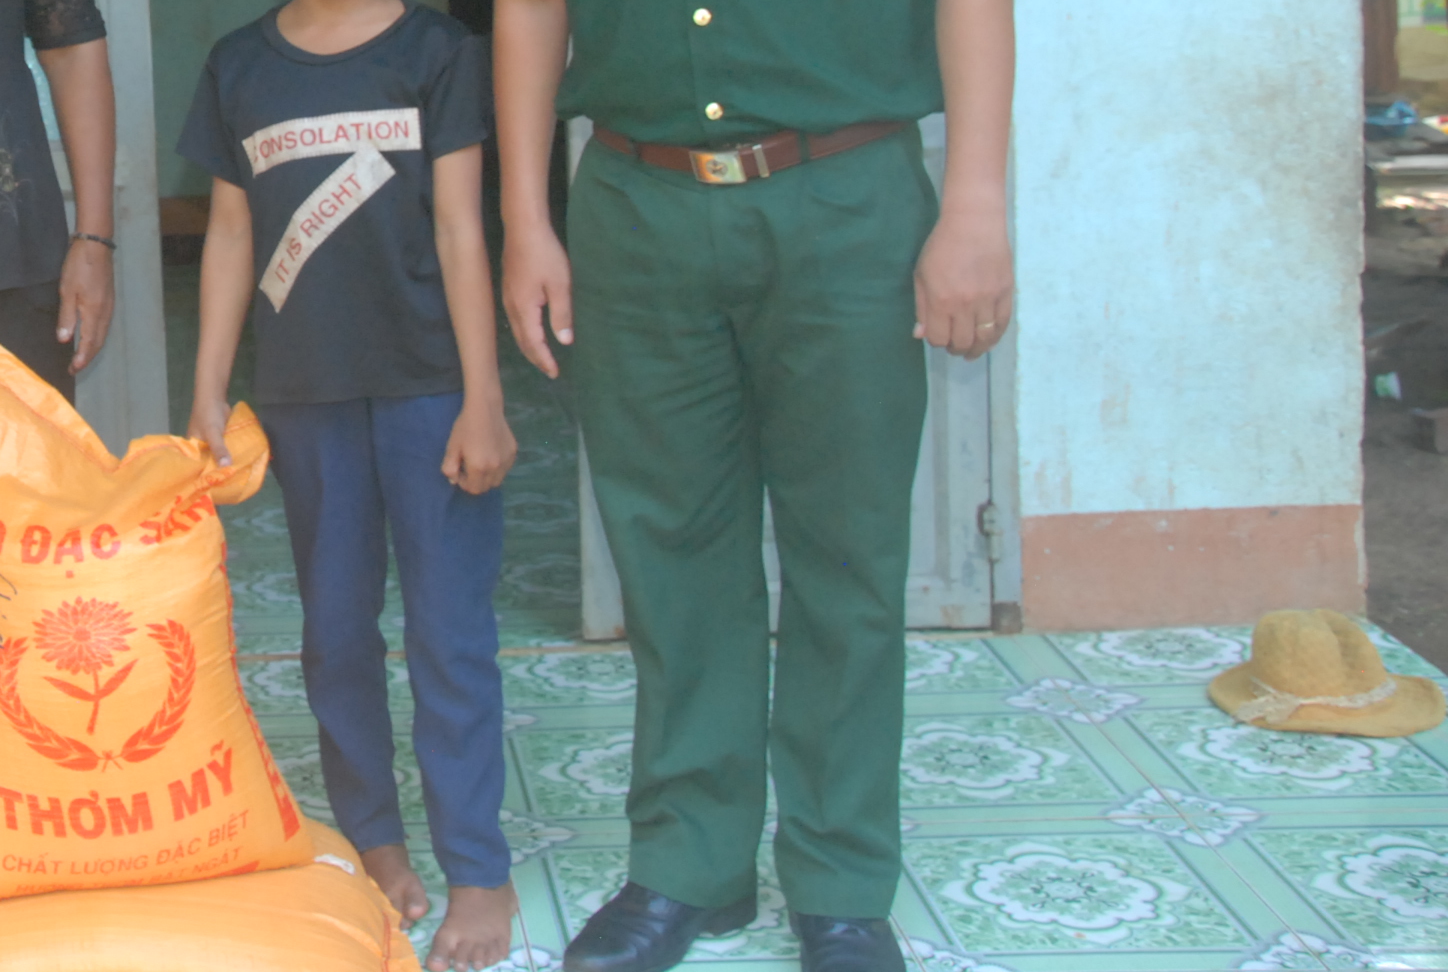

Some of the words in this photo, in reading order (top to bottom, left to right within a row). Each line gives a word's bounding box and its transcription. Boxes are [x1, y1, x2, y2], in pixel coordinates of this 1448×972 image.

[253, 120, 411, 164] ONSOLATION
[274, 258, 291, 284] IT
[286, 237, 303, 262] IS
[299, 173, 363, 238] RIGHT
[167, 739, 234, 822] MỸ
[2, 852, 63, 875] CHẤT
[69, 854, 149, 877] LƯỢNG
[208, 809, 250, 847] BIỆT
